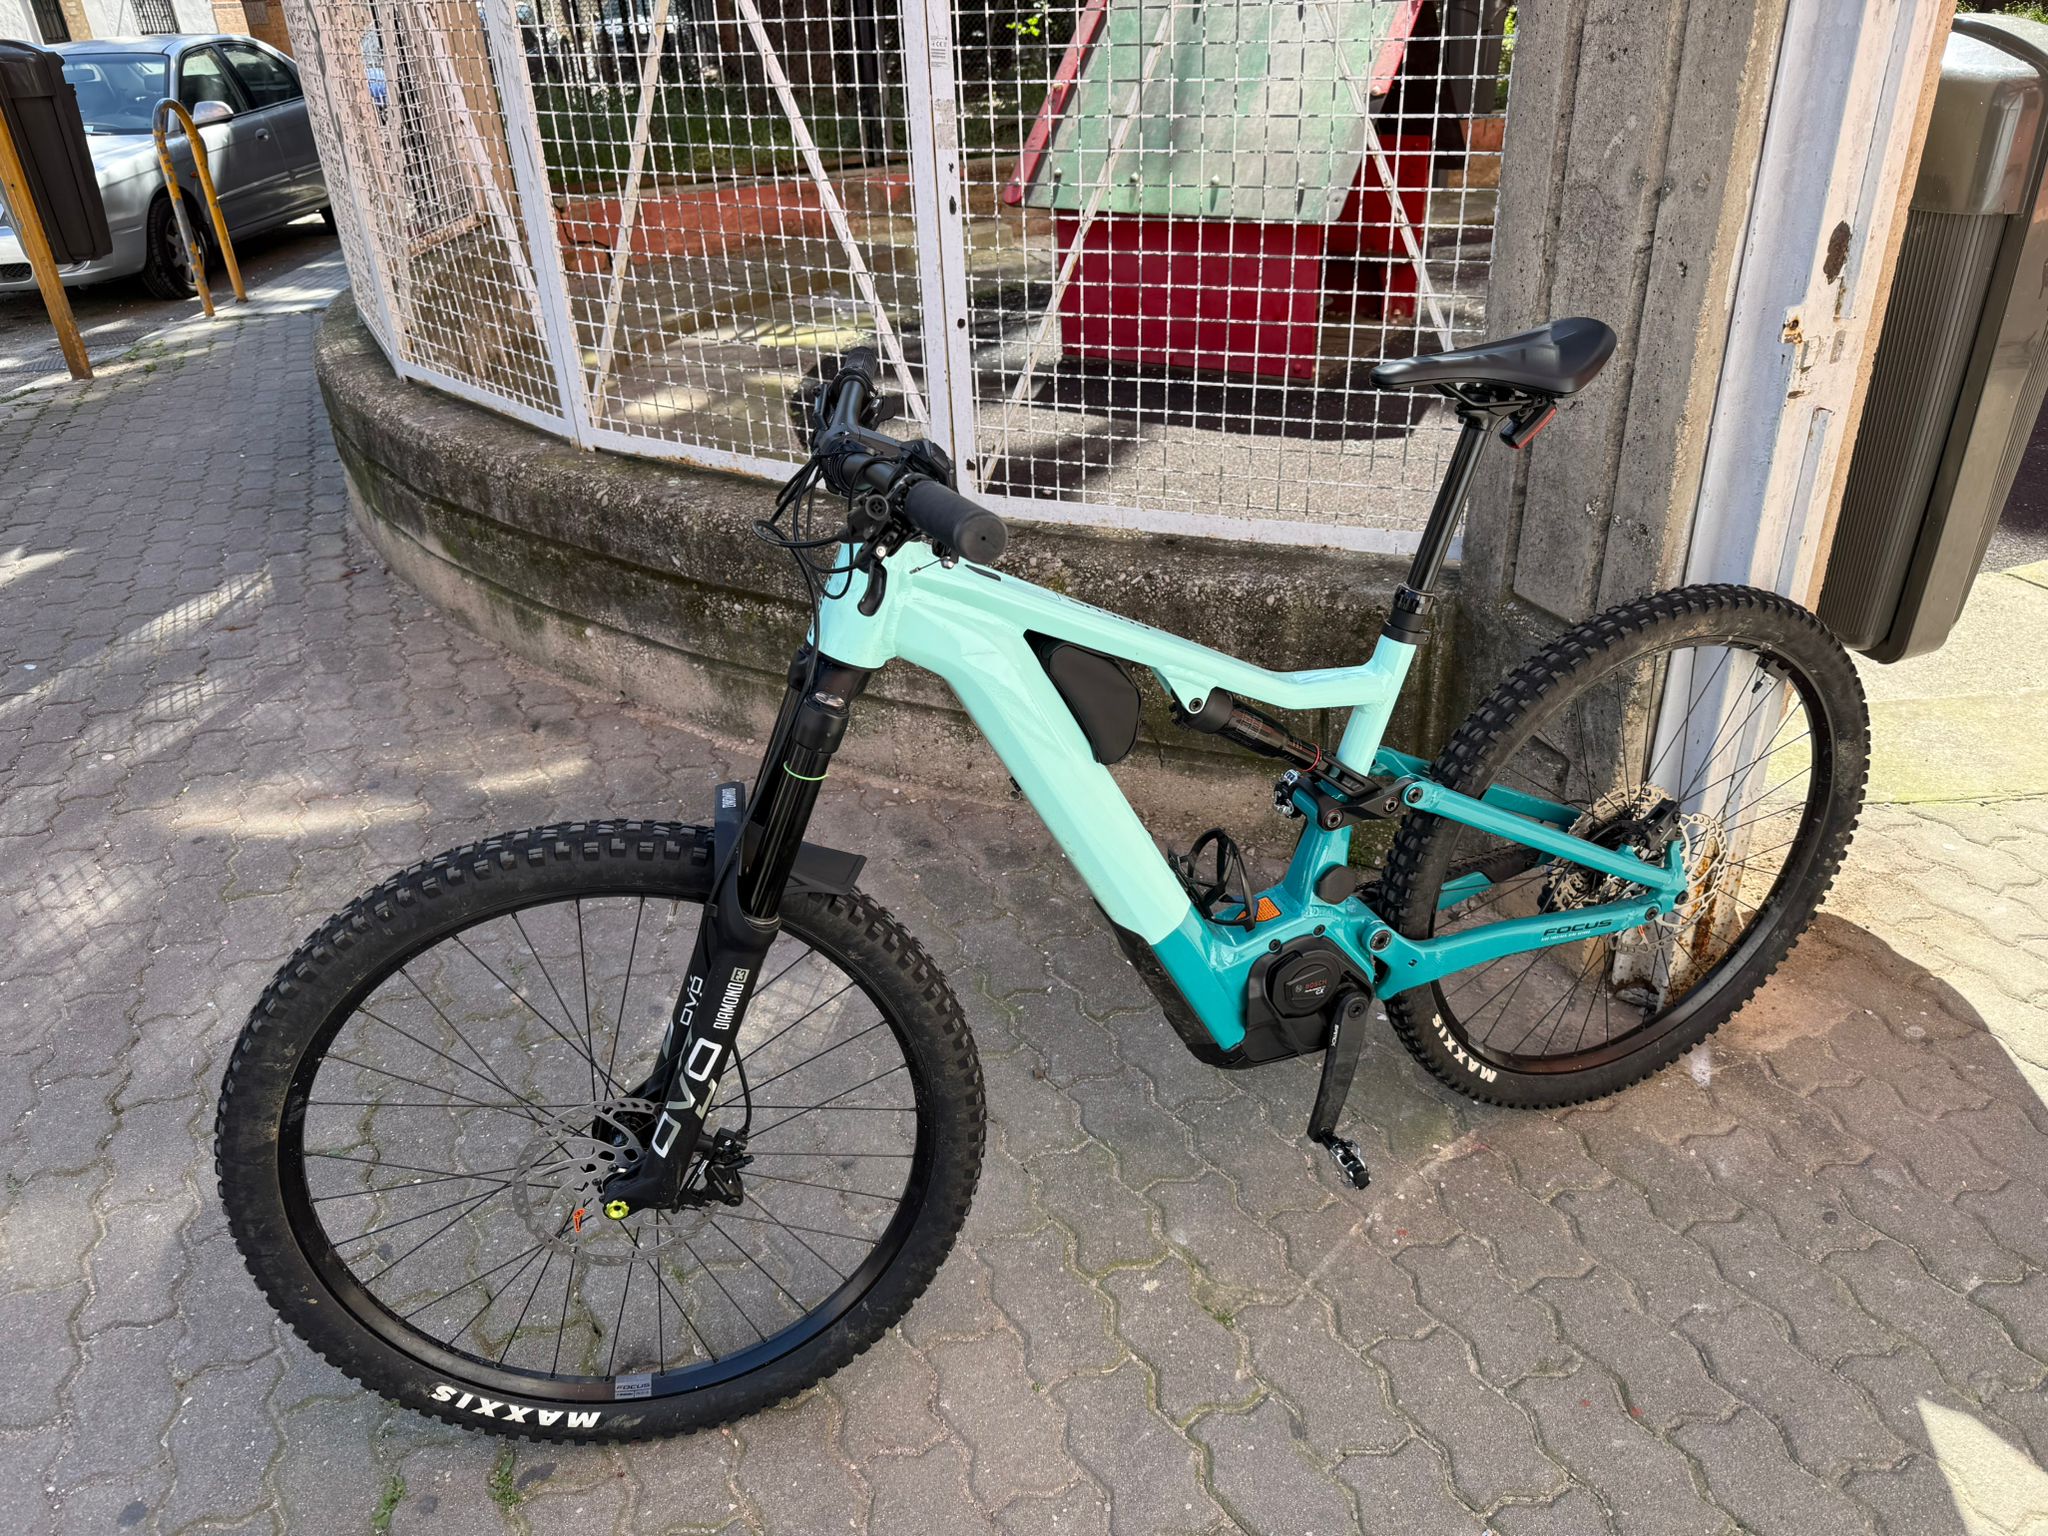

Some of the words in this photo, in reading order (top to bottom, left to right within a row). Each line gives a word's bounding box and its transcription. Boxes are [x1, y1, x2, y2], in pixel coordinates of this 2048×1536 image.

[1543, 919, 1613, 936] FOCUS
[1304, 979, 1328, 989] BOSCH
[713, 982, 745, 1030] DIAMOND
[1432, 1013, 1498, 1083] MAXXIS
[616, 1382, 651, 1390] FOCUS
[431, 1385, 601, 1429] MAXXIS
